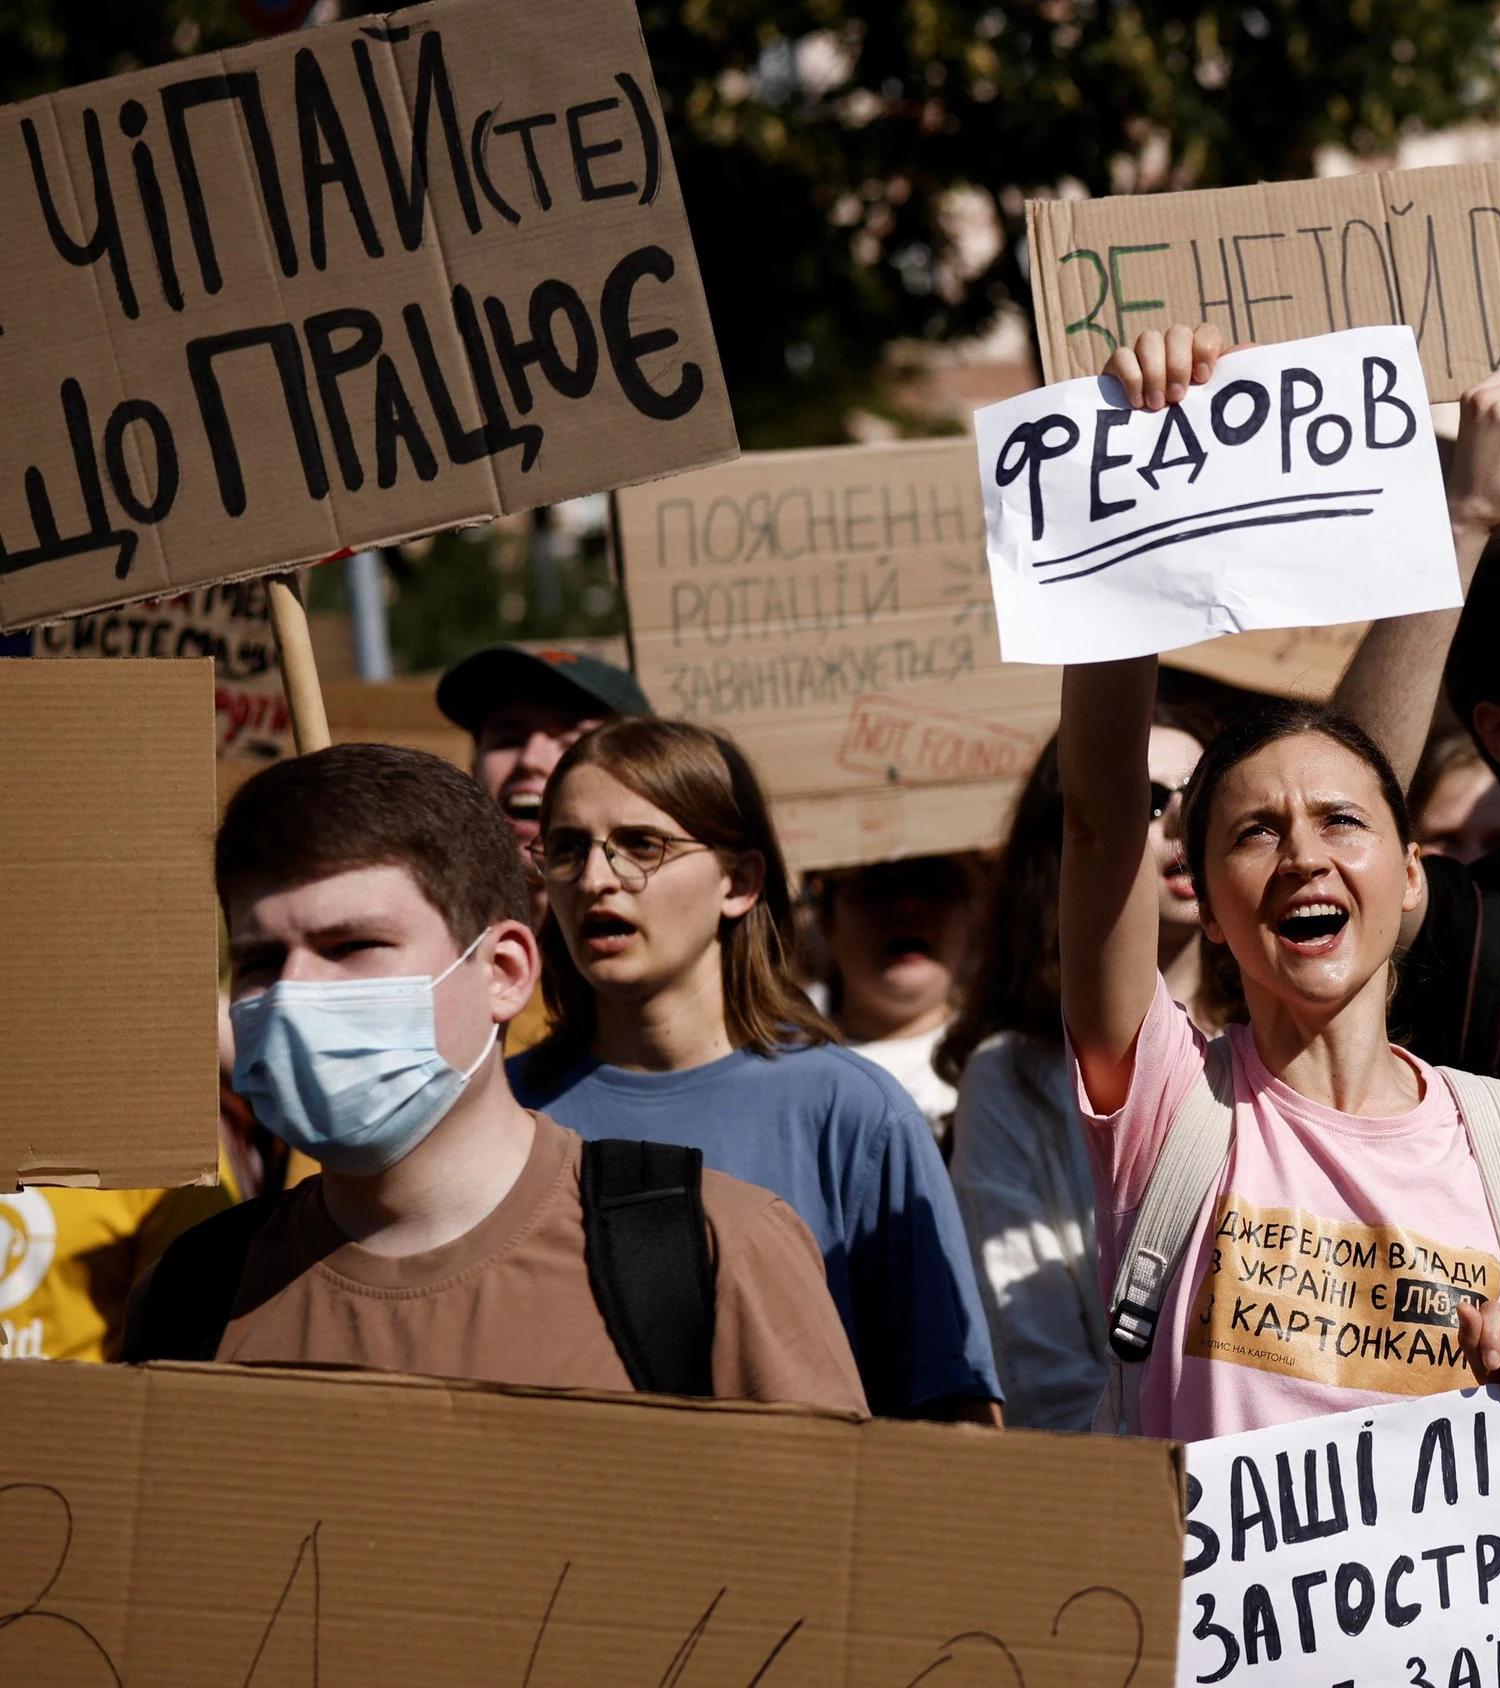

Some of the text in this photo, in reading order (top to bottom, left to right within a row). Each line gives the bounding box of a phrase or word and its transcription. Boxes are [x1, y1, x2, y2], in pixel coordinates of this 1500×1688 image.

[187, 246, 704, 518] ПРАЦЮЄ
[995, 355, 1418, 542] ФЕДОРОВ
[656, 484, 986, 568] ПОЯСНЕНН
[670, 557, 900, 648] РОТАЦІЙ
[854, 711, 1019, 777] NOT FOUND
[1215, 1210, 1488, 1287] ДЖЕРЕЛОМ ВЛАДИ
[1238, 1255, 1358, 1309] УКРАЇНІ
[1370, 1284, 1388, 1310] Є
[1231, 1295, 1468, 1370] КАРТОНКАМ
[1232, 1344, 1246, 1355] НА
[1247, 1348, 1296, 1366] КАРТОНЦІ
